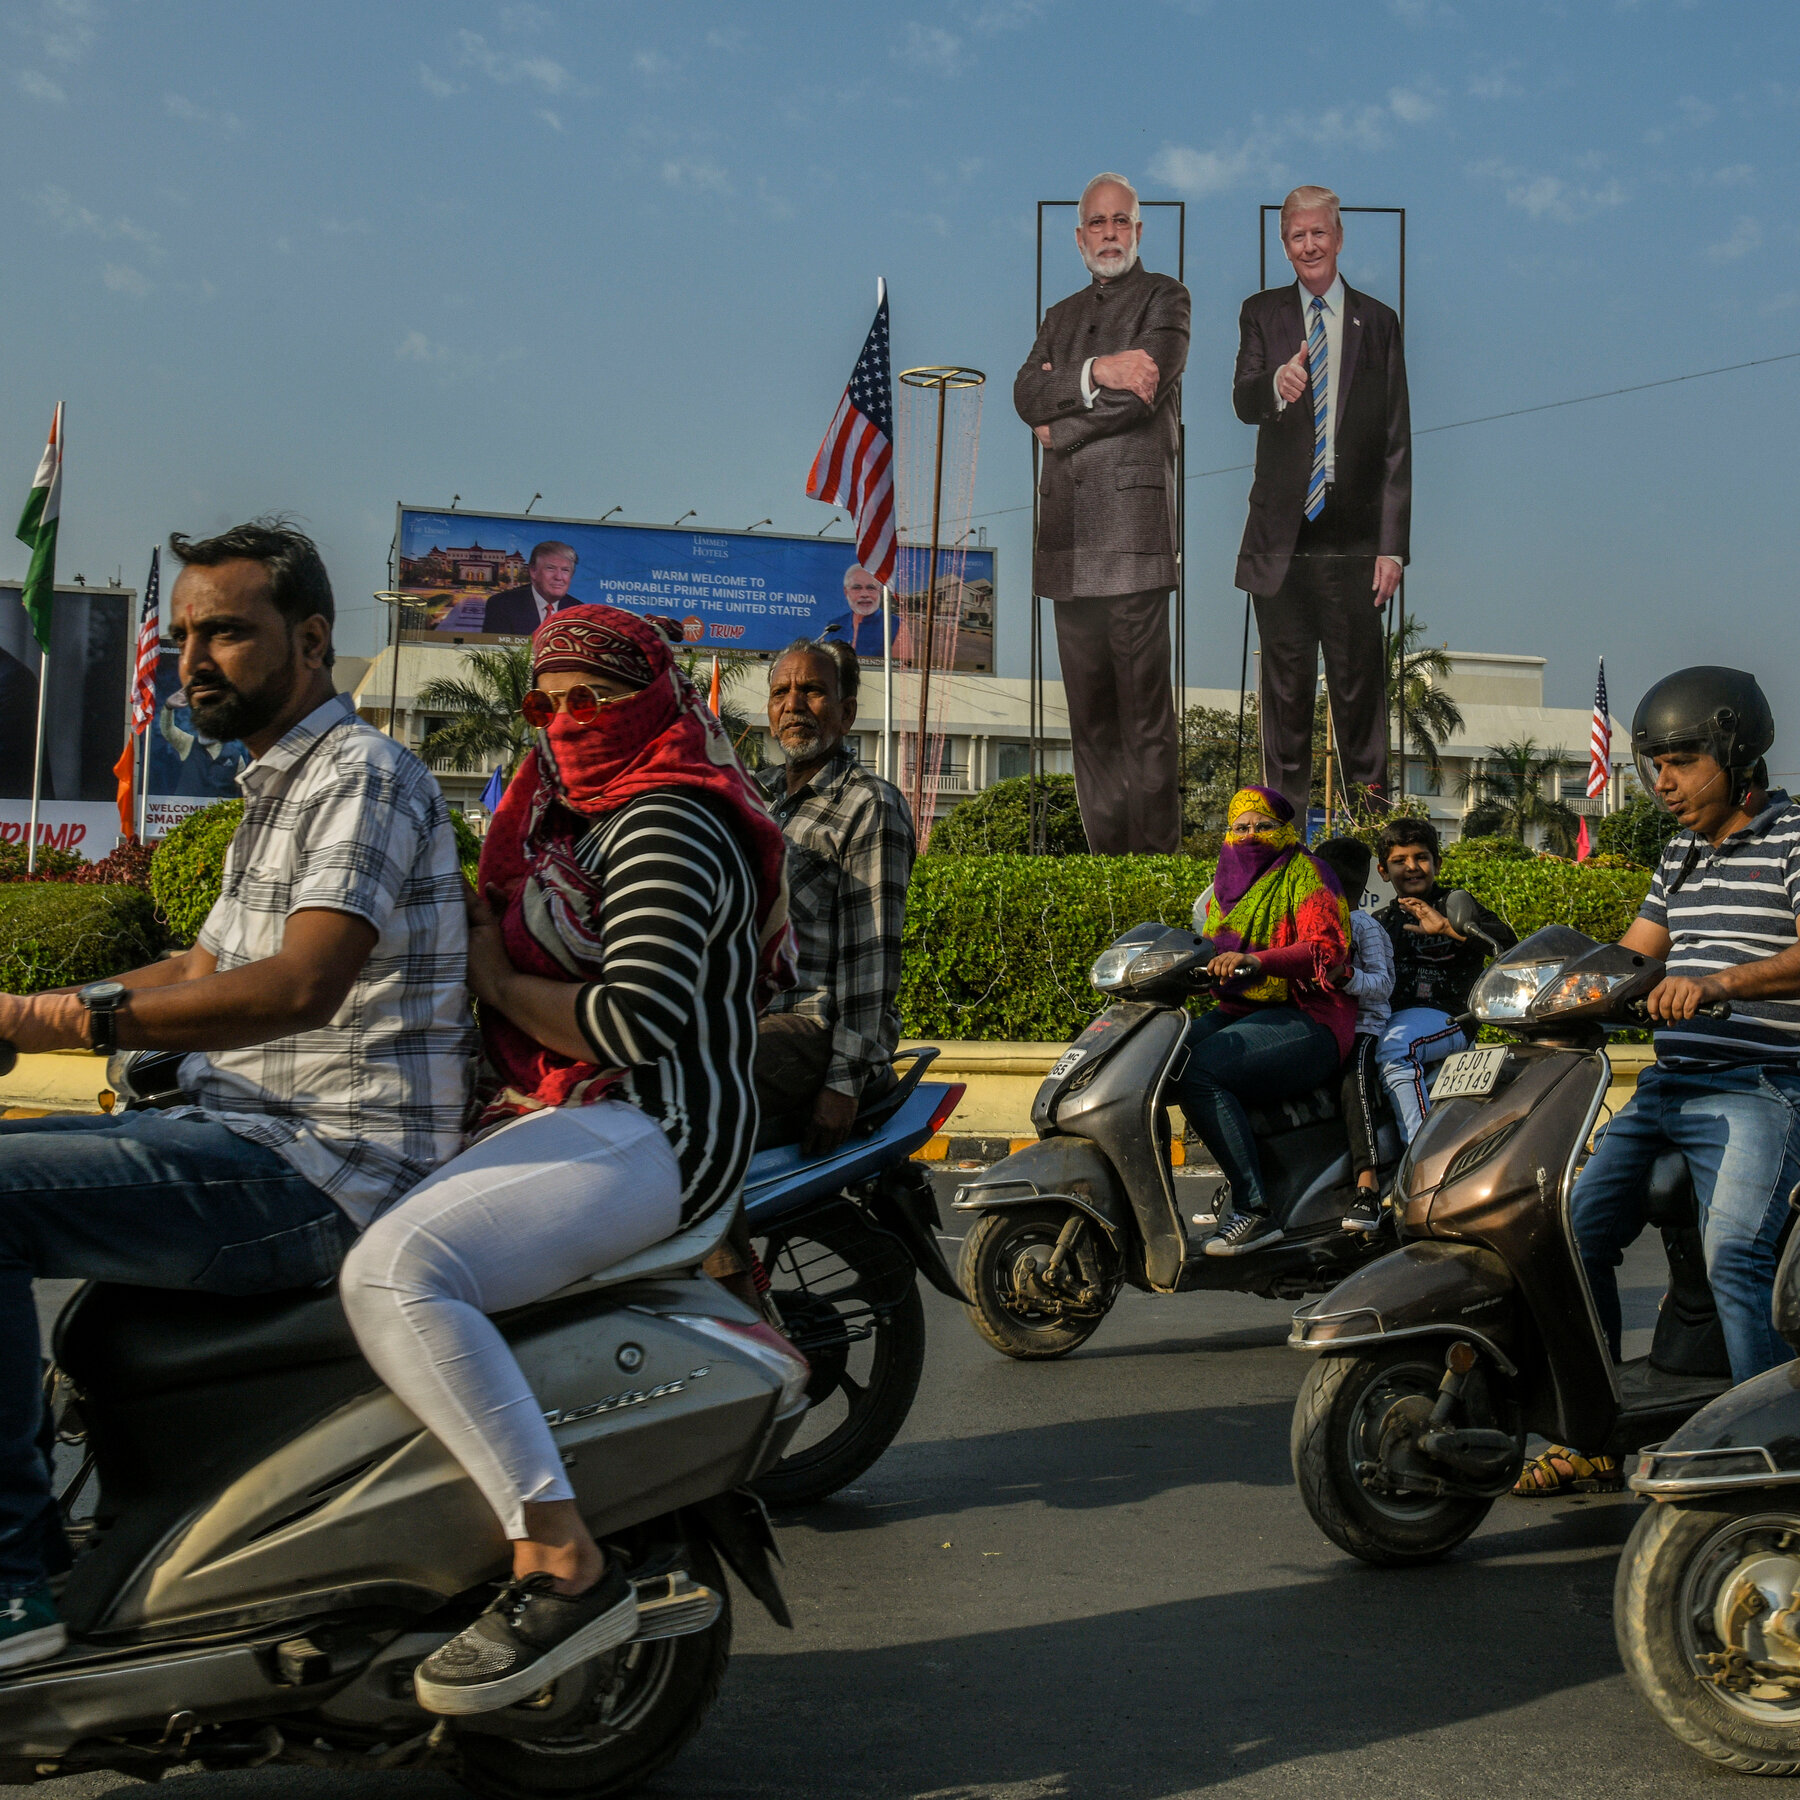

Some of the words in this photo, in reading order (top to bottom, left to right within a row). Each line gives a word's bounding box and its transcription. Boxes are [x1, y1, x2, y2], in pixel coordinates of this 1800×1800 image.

[692, 546, 729, 558] HOTELS
[652, 569, 688, 582] WARM
[691, 572, 747, 587] WELCOME
[750, 577, 765, 588] TO
[600, 580, 671, 594] HONORABLE
[673, 584, 709, 597] PRIME
[712, 588, 766, 601] MINISTER
[769, 592, 784, 602] OF
[786, 593, 817, 604] INDIA
[606, 594, 614, 603] &
[617, 594, 680, 608] PRESIDENT
[683, 598, 699, 609] OF
[701, 600, 723, 611] THE
[725, 602, 767, 614] UNITED
[769, 606, 811, 617] STATES
[709, 623, 745, 639] TRUMP
[149, 803, 206, 813] WELCOME
[146, 814, 187, 824] SMAR
[1064, 1052, 1080, 1061] MC
[1456, 1050, 1492, 1072] GJ01
[1439, 1071, 1492, 1095] PX5149
